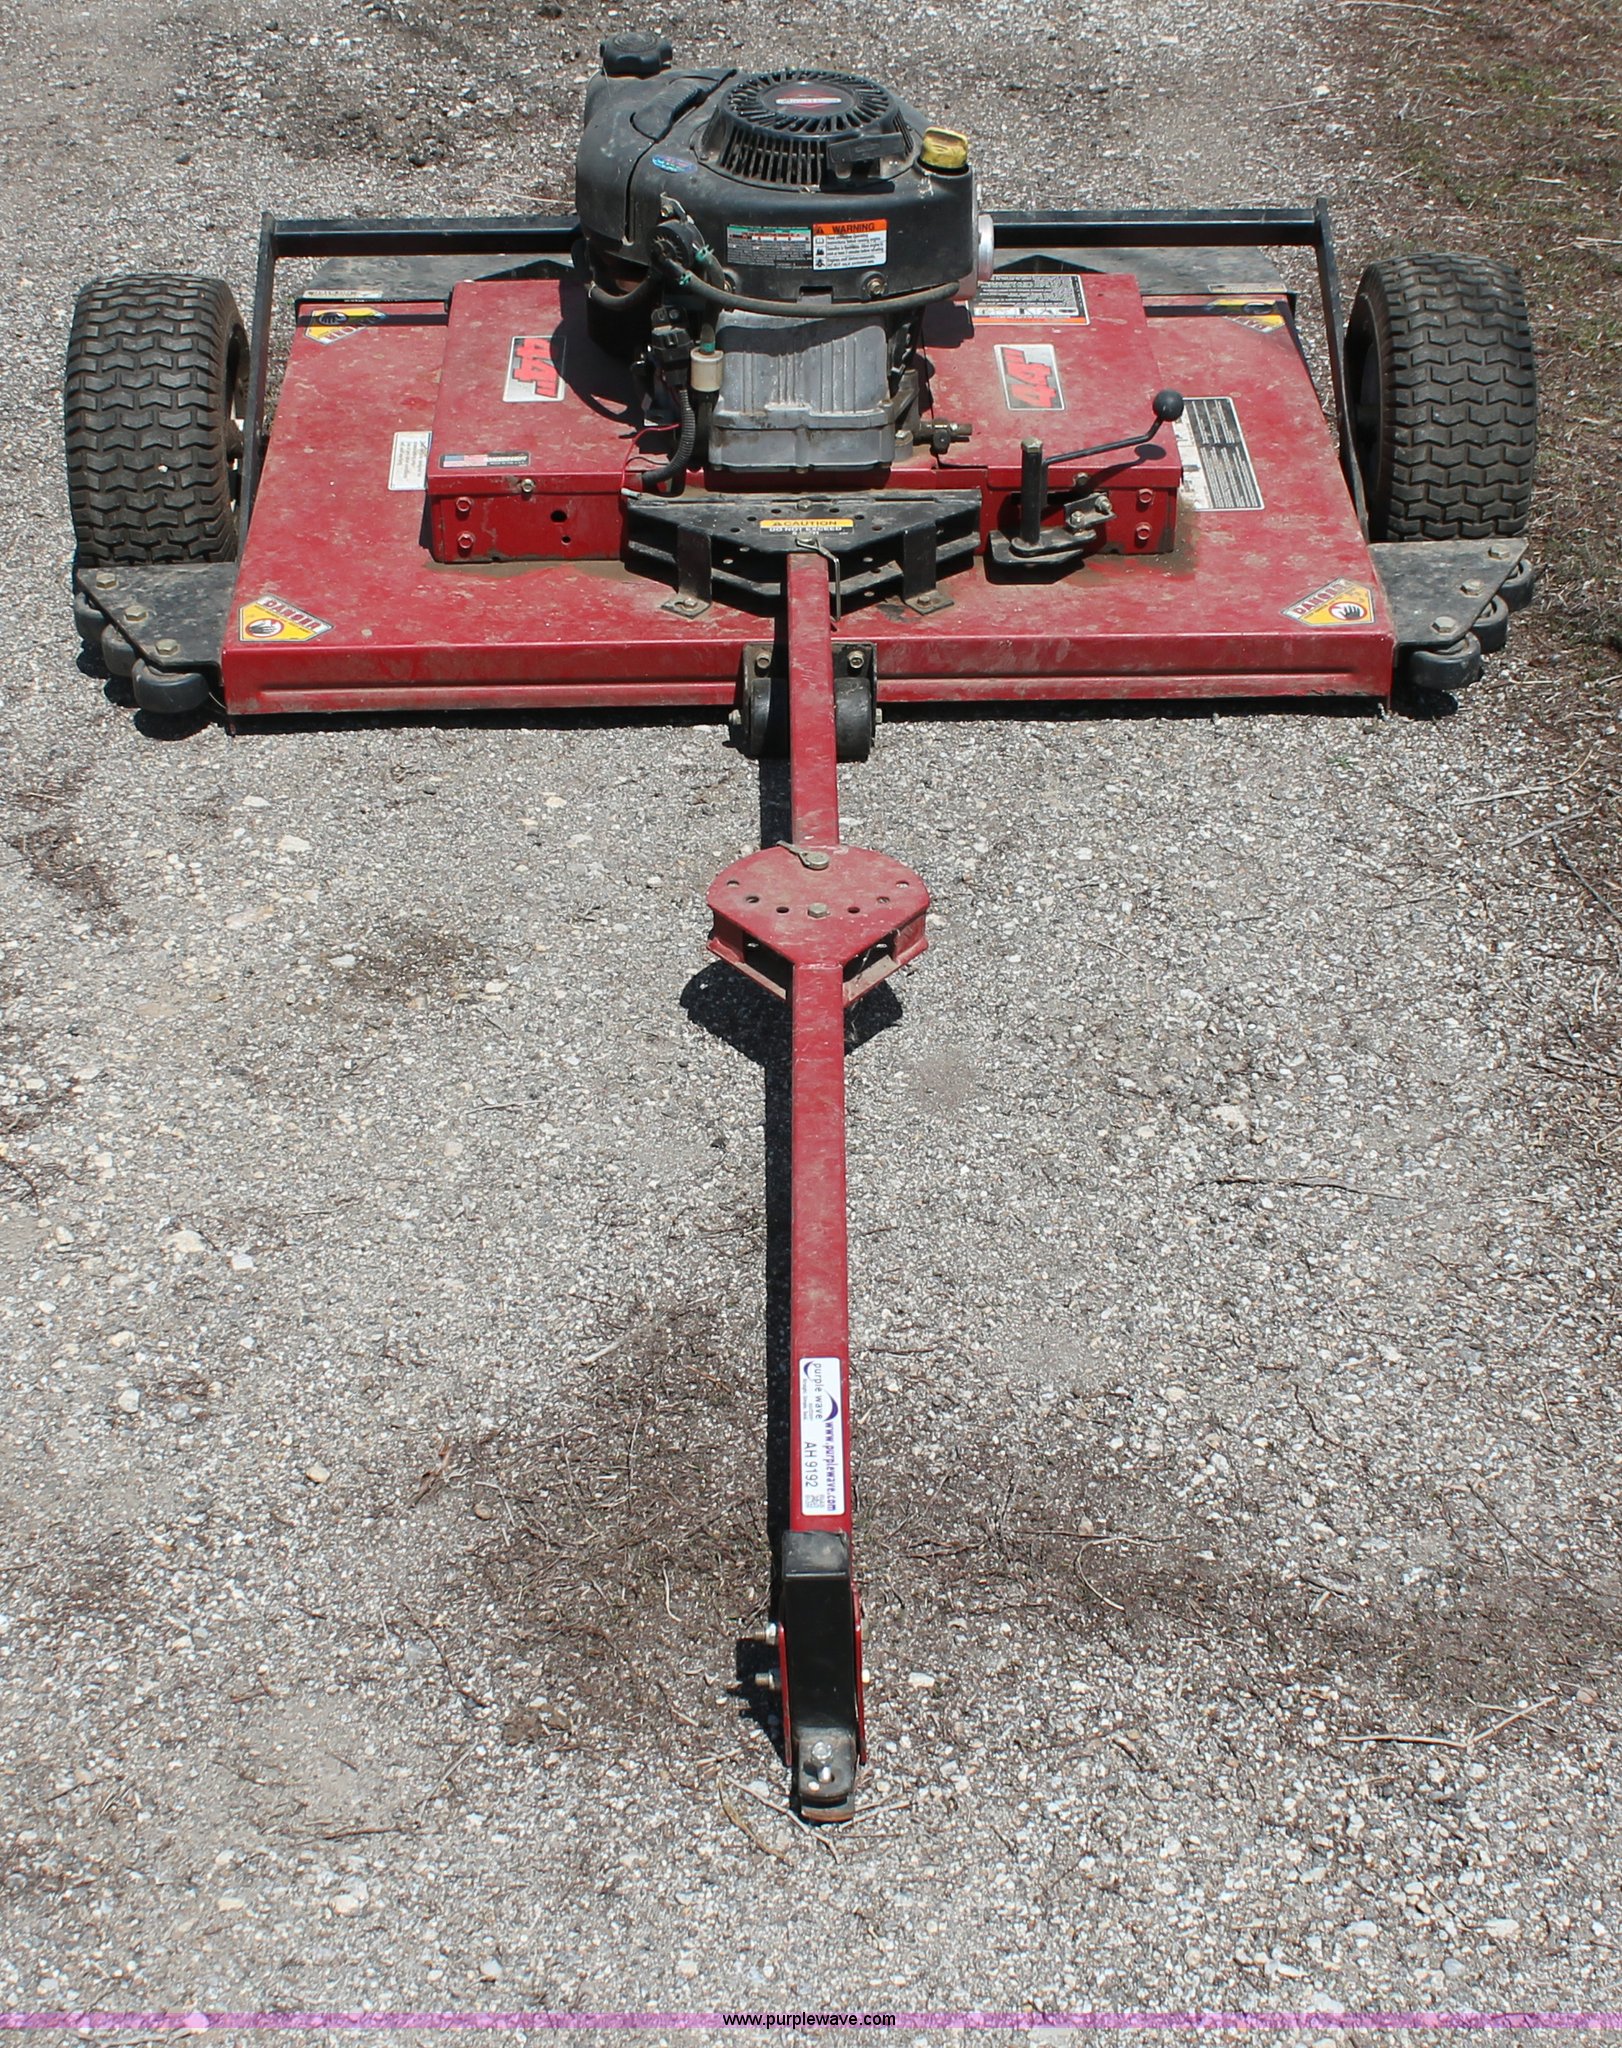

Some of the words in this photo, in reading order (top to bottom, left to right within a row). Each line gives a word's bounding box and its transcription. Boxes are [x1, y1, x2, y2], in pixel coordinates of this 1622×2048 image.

[832, 223, 875, 234] WARNING
[1292, 583, 1346, 615] DANGER
[263, 599, 322, 630] DANGER
[813, 1363, 824, 1392] purple
[815, 1395, 823, 1419] wave
[804, 1441, 817, 1458] AH
[805, 1461, 818, 1488] 9192
[823, 1422, 838, 1511] www.purplewave.com
